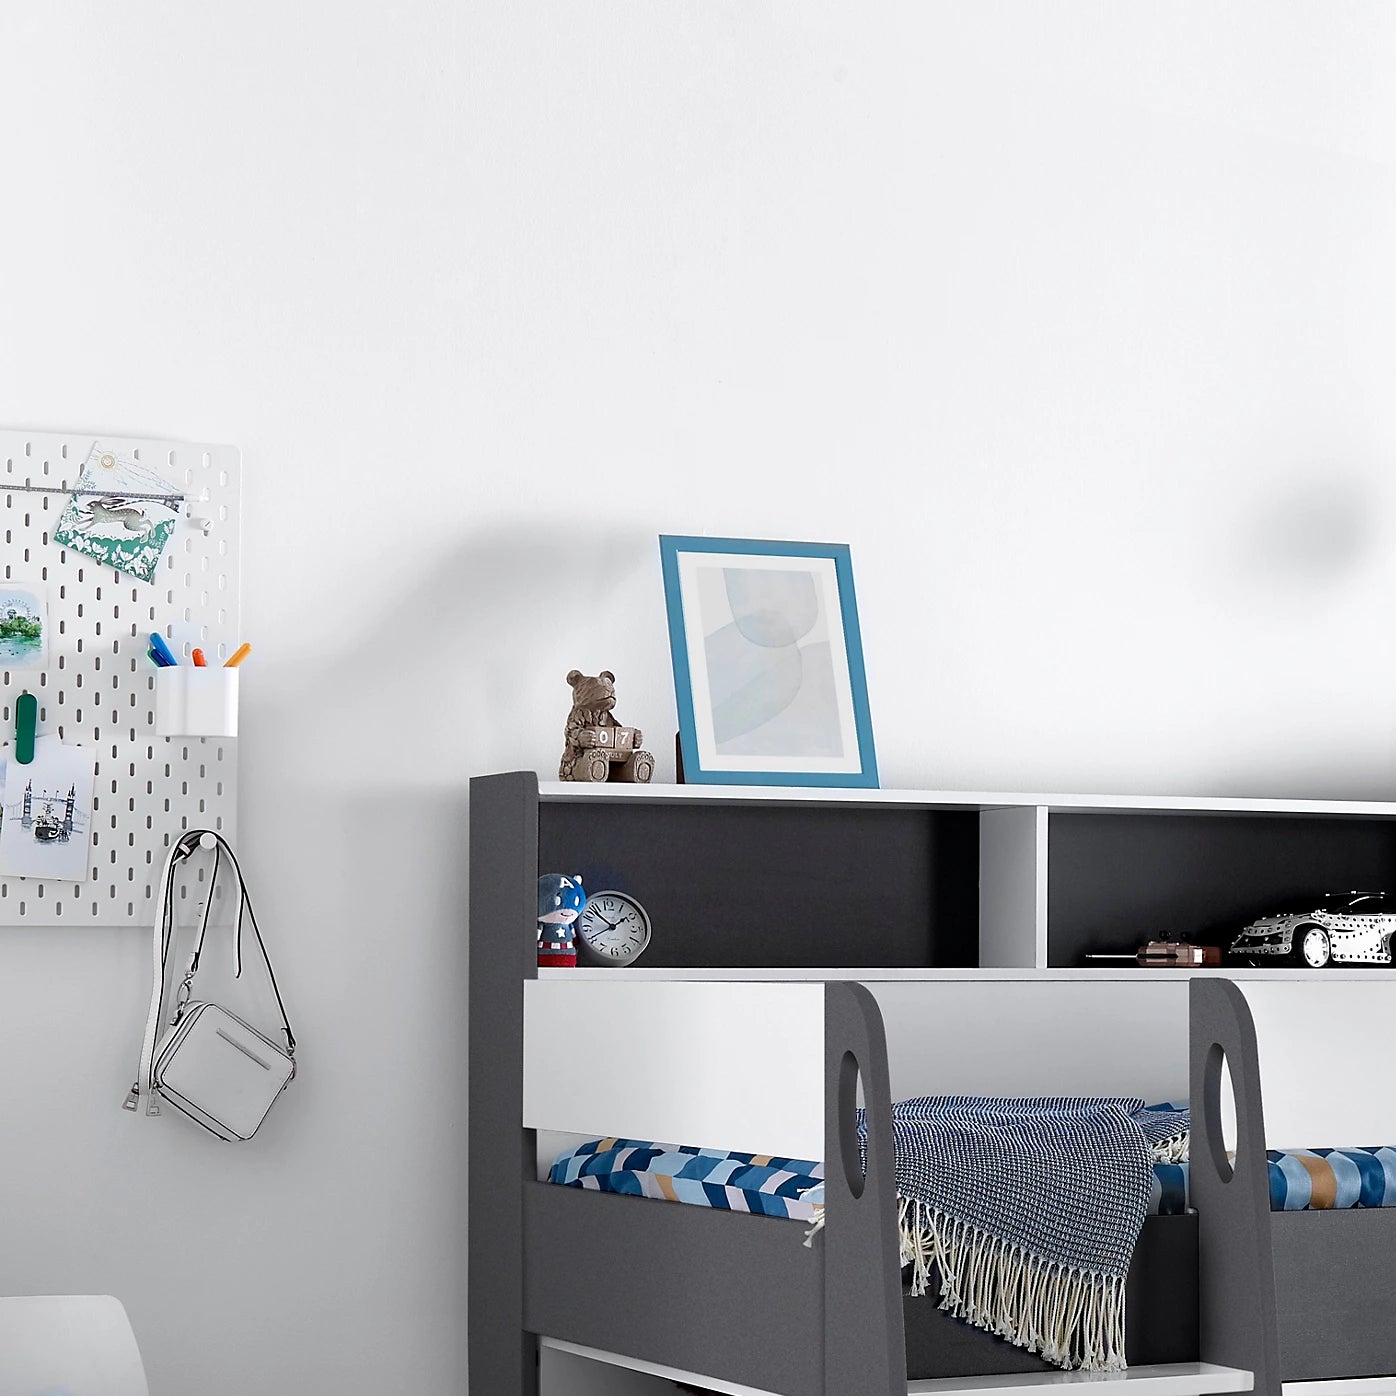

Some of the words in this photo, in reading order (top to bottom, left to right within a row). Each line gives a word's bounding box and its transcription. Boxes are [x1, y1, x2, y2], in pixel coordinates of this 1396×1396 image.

[560, 877, 575, 889] A
[603, 898, 614, 911] 12
[610, 946, 619, 957] 6
